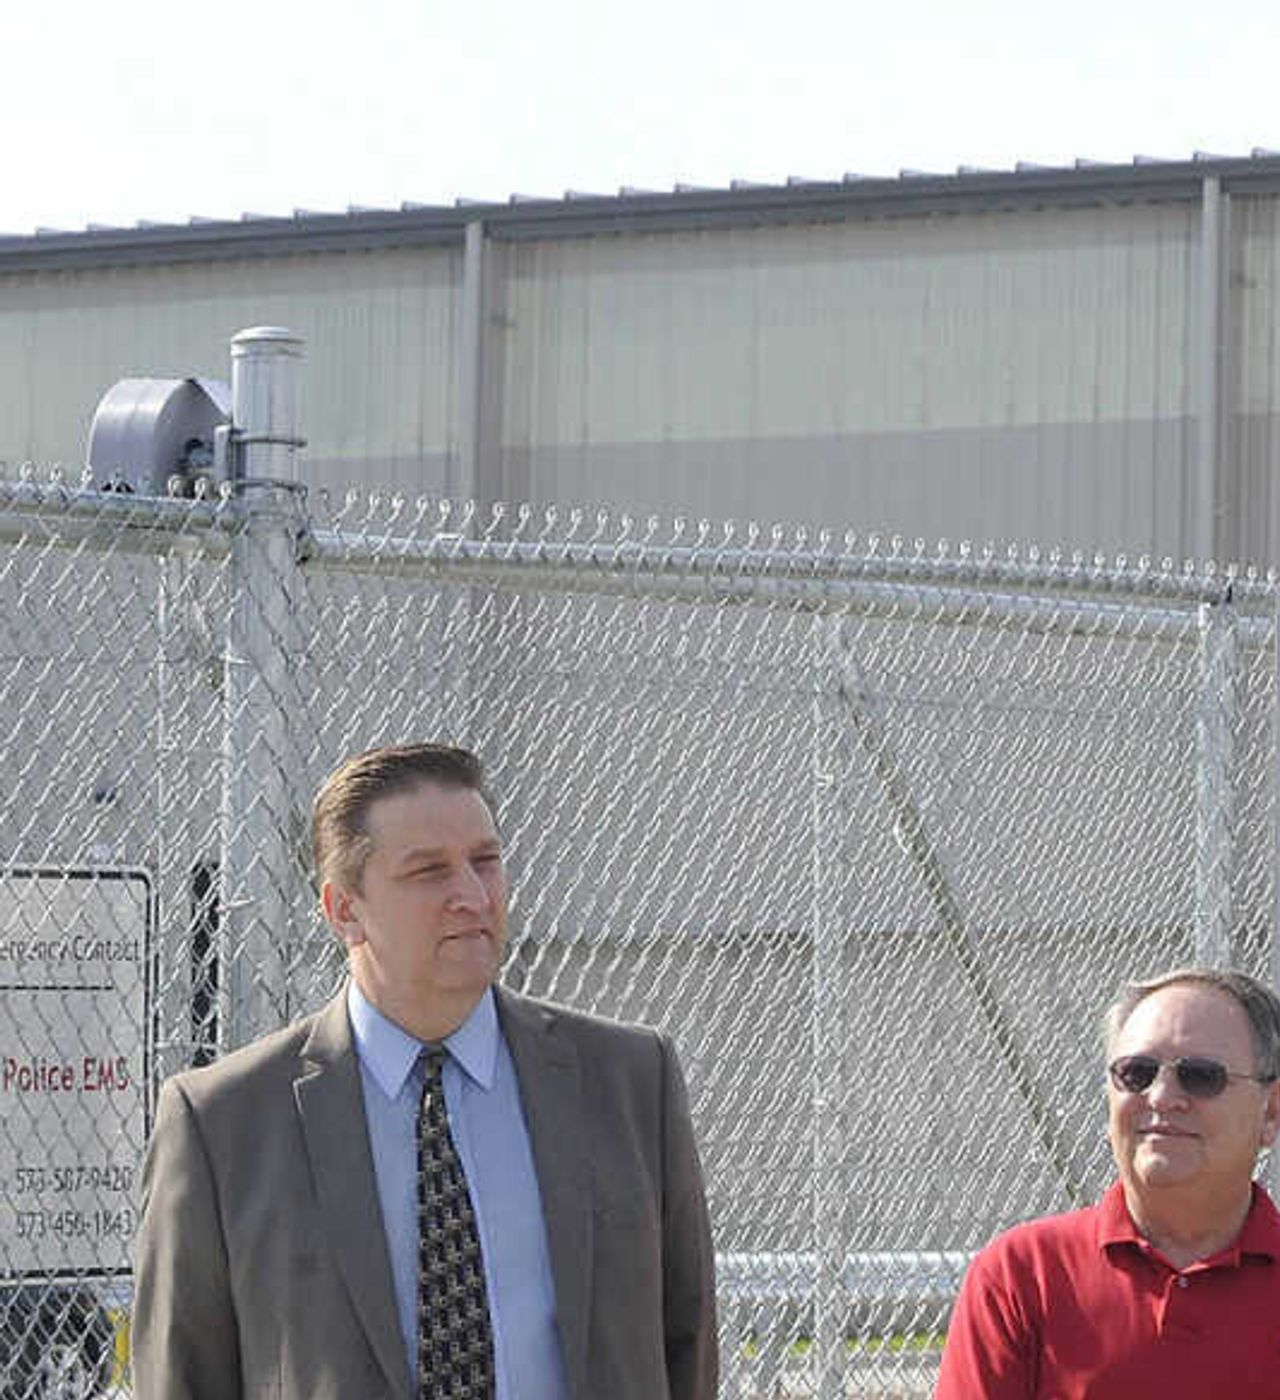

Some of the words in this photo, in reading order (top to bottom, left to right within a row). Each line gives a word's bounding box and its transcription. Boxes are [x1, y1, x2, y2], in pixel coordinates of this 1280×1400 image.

[72, 935, 140, 962] Contact
[3, 1056, 75, 1092] Police
[83, 1055, 132, 1091] EMS
